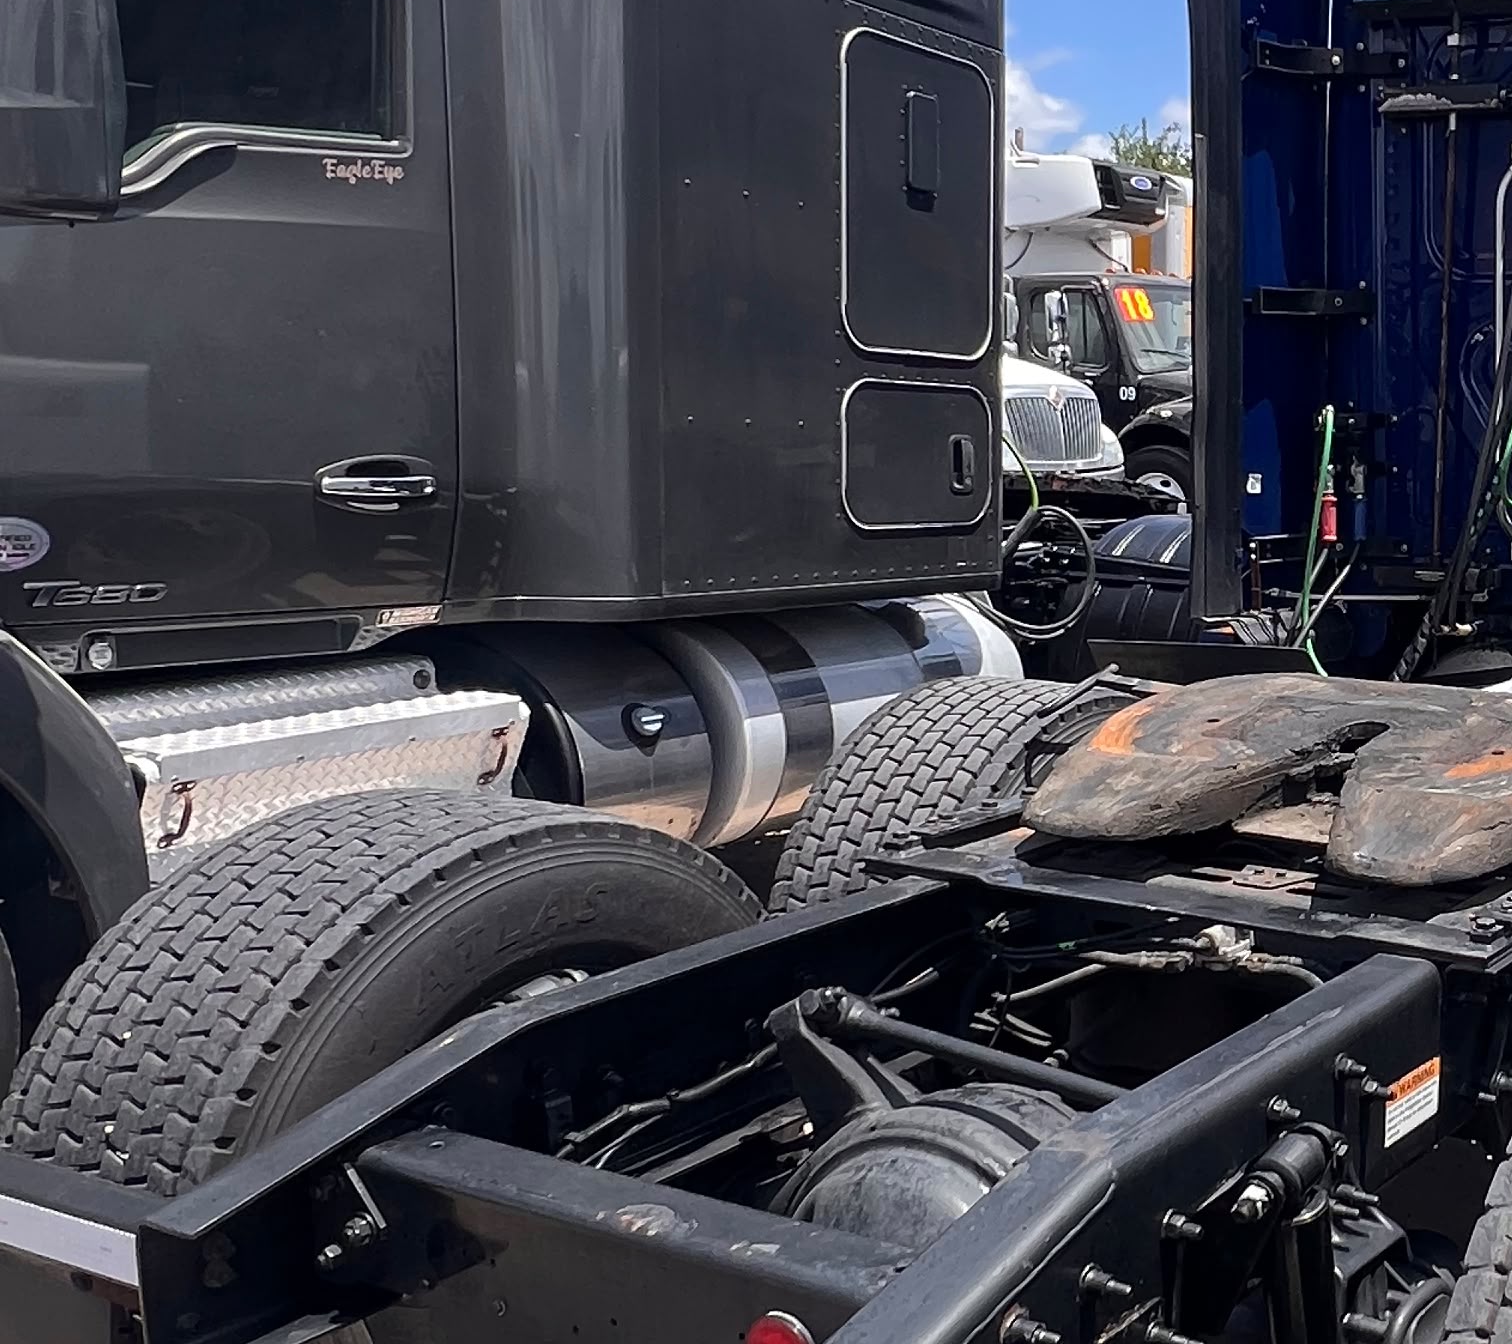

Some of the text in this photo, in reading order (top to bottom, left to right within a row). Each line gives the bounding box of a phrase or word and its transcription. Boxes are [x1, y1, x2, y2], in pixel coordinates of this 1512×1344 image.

[1122, 288, 1154, 321] 18
[1119, 387, 1136, 402] 09
[23, 580, 169, 607] T680
